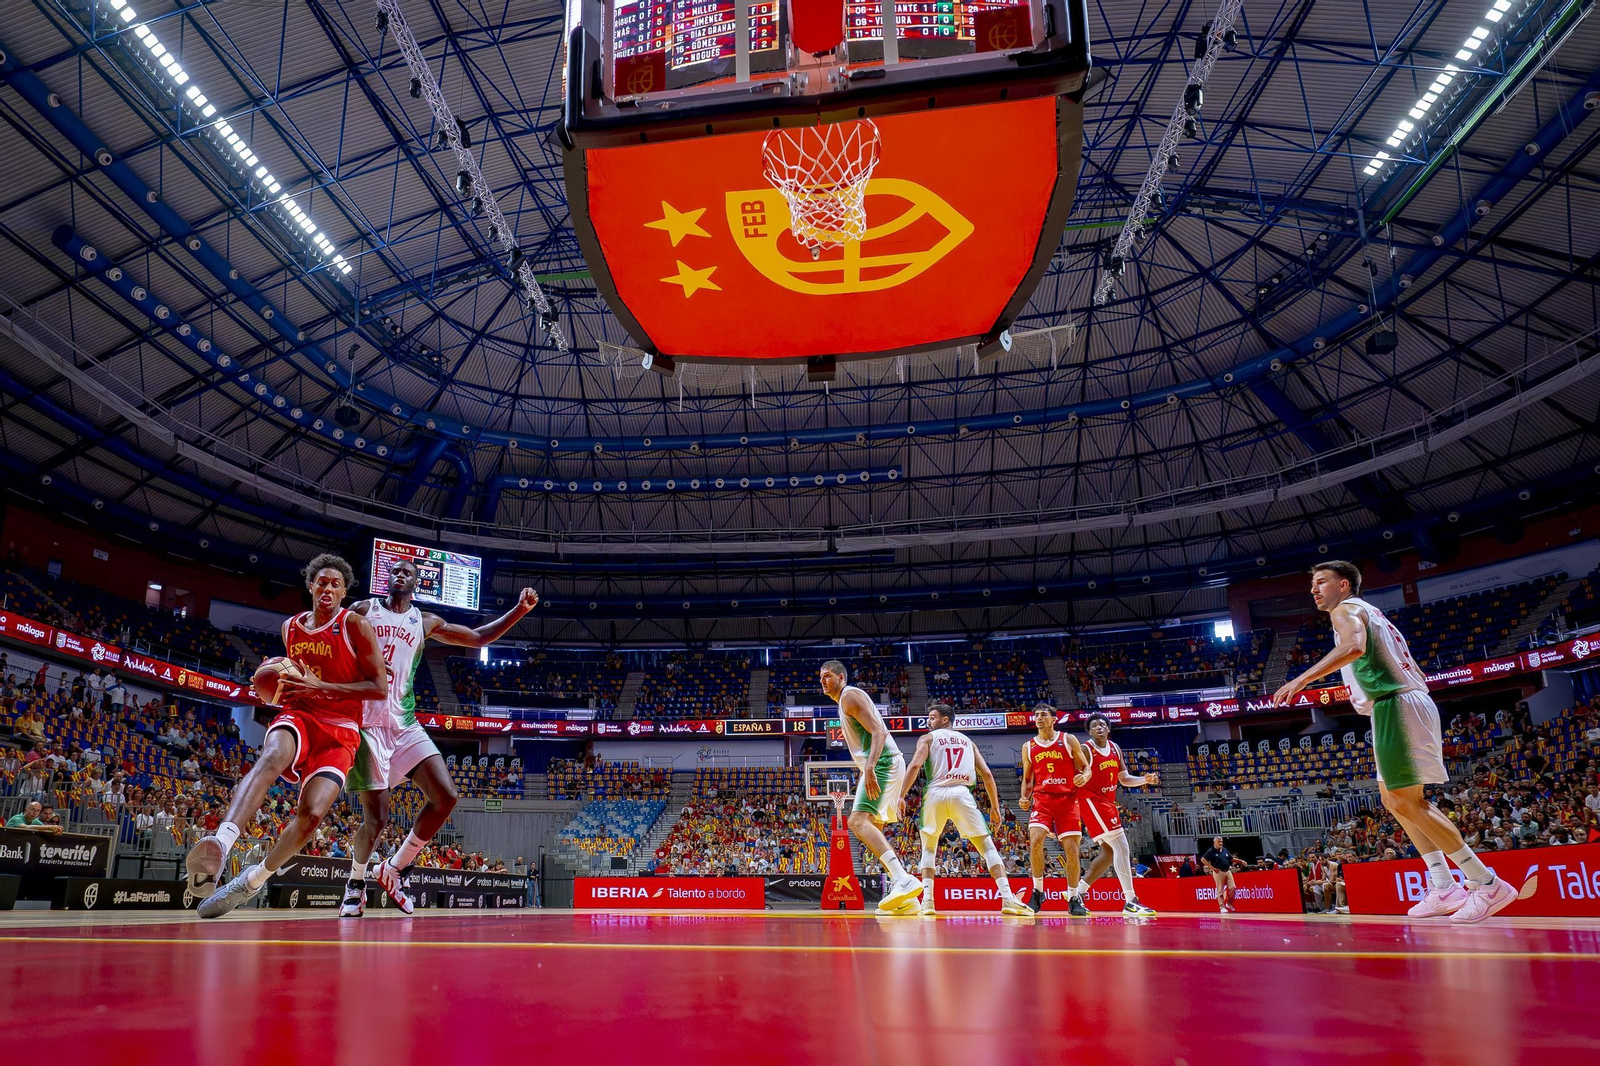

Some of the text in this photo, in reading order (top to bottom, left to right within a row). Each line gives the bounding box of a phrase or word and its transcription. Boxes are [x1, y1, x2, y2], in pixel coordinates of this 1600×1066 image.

[648, 9, 652, 17] F
[692, 4, 717, 16] MILLER
[933, 4, 937, 12] F
[647, 20, 651, 28] F
[647, 31, 651, 40] F
[752, 30, 756, 38] F
[647, 42, 651, 51] F
[752, 41, 756, 49] F
[676, 57, 684, 65] 17
[741, 200, 768, 238] FEB
[420, 570, 438, 579] 8:47
[17, 623, 45, 638] málaga
[290, 641, 332, 658] ESPAÑA
[382, 644, 395, 661] 21
[1483, 662, 1515, 673] málaga
[206, 680, 230, 693] IBERIA
[733, 723, 764, 732] ESPAÑA
[794, 721, 806, 731] 18
[889, 719, 904, 729] 12
[918, 718, 930, 728] 2
[955, 718, 1000, 726] PORTUGAL
[829, 728, 844, 740] 12
[950, 738, 968, 747] SILVA
[945, 747, 964, 772] 17
[1035, 750, 1063, 763] ESPAÑA
[1046, 763, 1054, 773] 5
[1099, 760, 1118, 770] ESPAÑA
[1042, 777, 1066, 786] endesa
[301, 865, 328, 878] endesa
[788, 879, 821, 888] endesa
[113, 891, 170, 904] #LaFamilia
[591, 887, 746, 898] IBERIA Talento a bordo
[944, 889, 1004, 900] IBERIA
[1255, 885, 1274, 899] bordo
